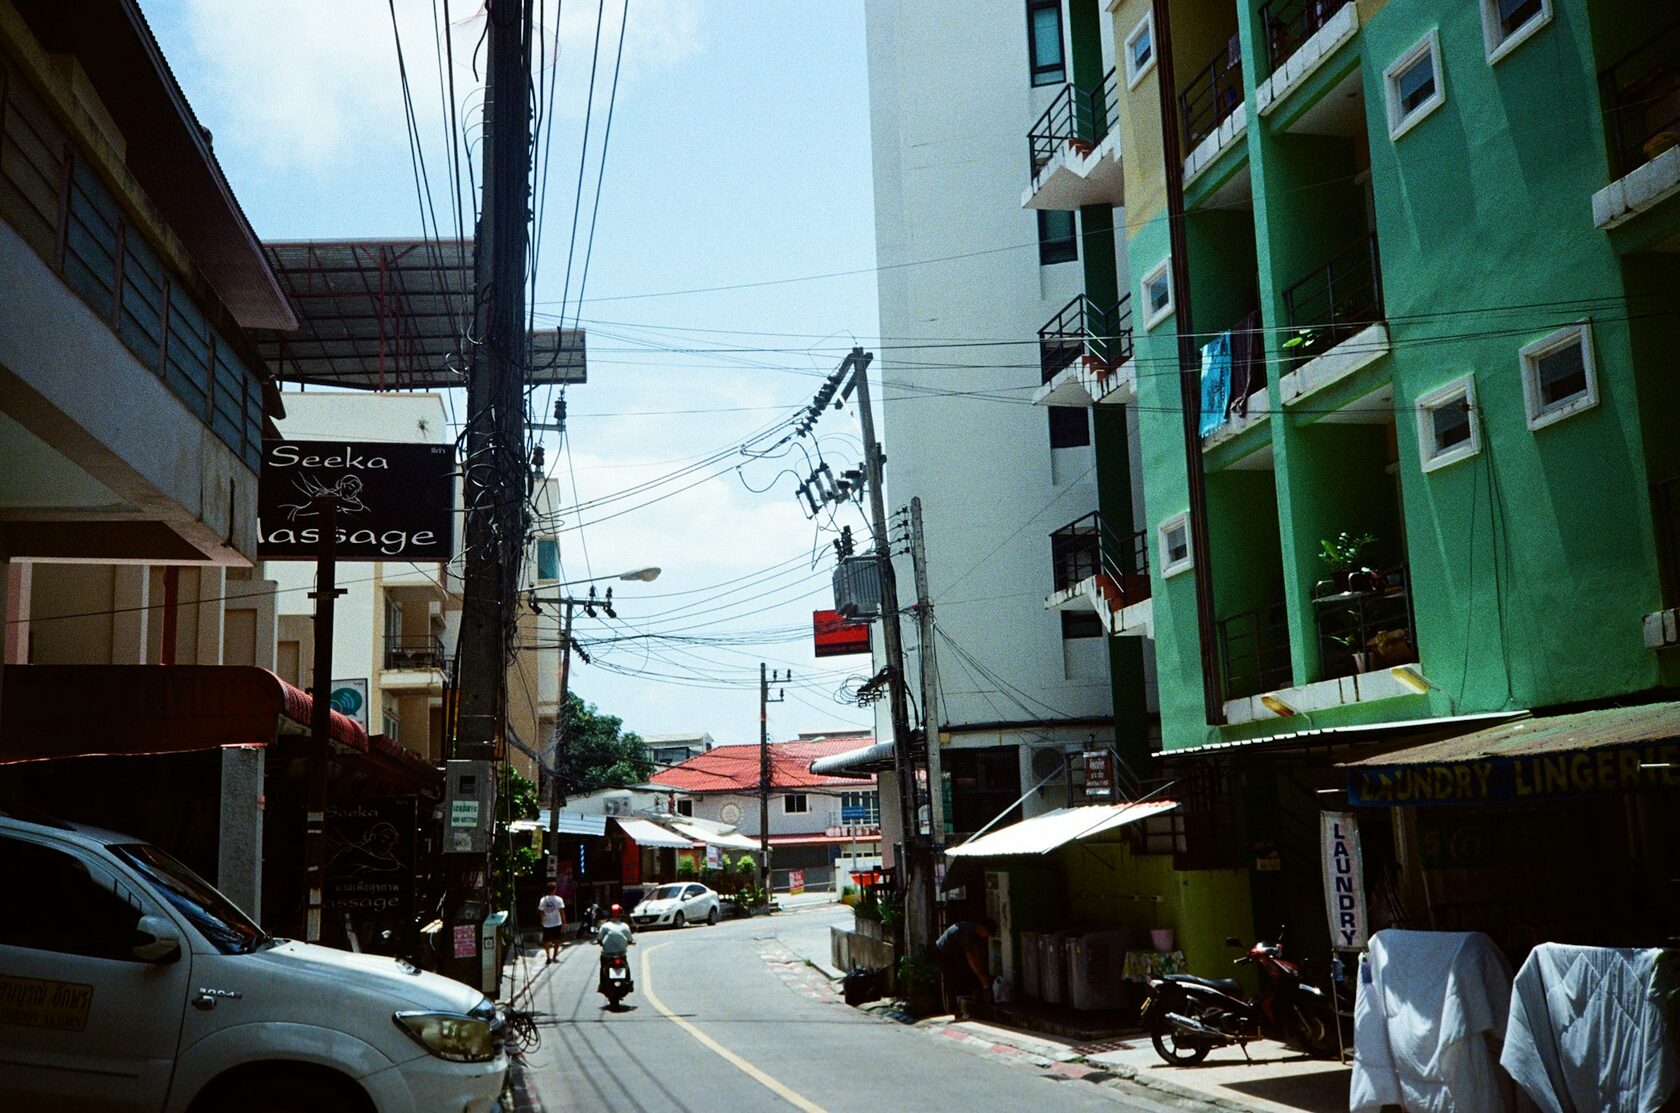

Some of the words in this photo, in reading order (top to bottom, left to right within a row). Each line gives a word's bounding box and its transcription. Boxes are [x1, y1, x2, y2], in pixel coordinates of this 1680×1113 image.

[268, 445, 389, 470] Seeka
[257, 517, 437, 555] assage
[1359, 762, 1494, 802] LAUNDRY
[1513, 745, 1680, 797] LINGERIE
[1334, 823, 1356, 946] LAUNDRY
